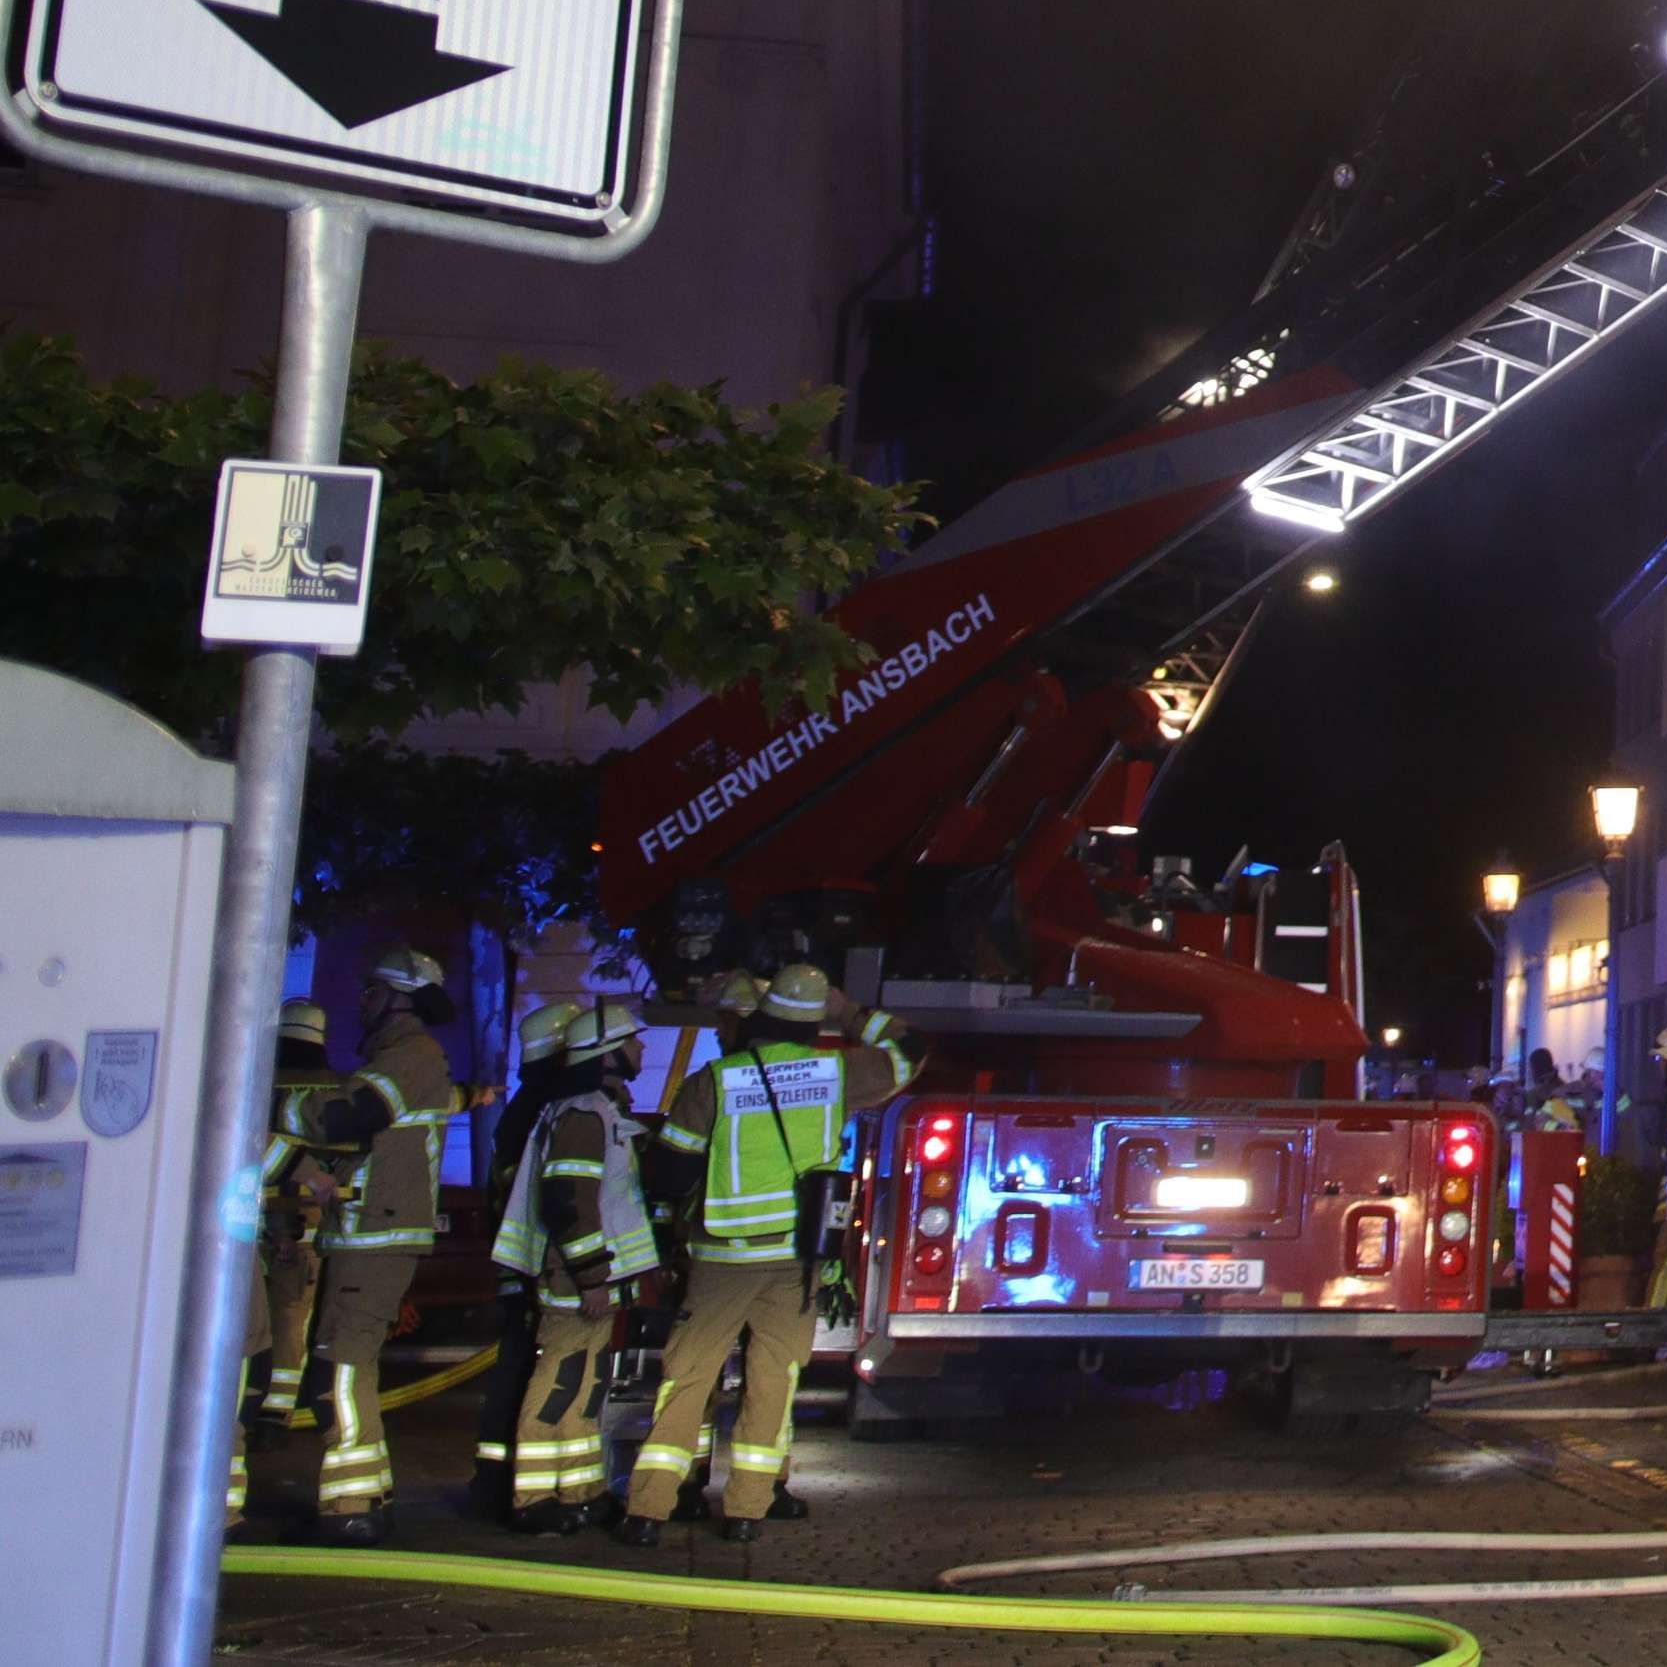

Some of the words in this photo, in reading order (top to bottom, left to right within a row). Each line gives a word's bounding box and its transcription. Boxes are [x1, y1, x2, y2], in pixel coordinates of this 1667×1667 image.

[637, 711, 840, 864] FEUERWEHR
[839, 592, 995, 724] ANSBACH
[735, 1086, 829, 1110] EINSZLEITER
[1146, 1263, 1175, 1284] AN
[1190, 1263, 1204, 1284] S
[1209, 1263, 1249, 1284] 358
